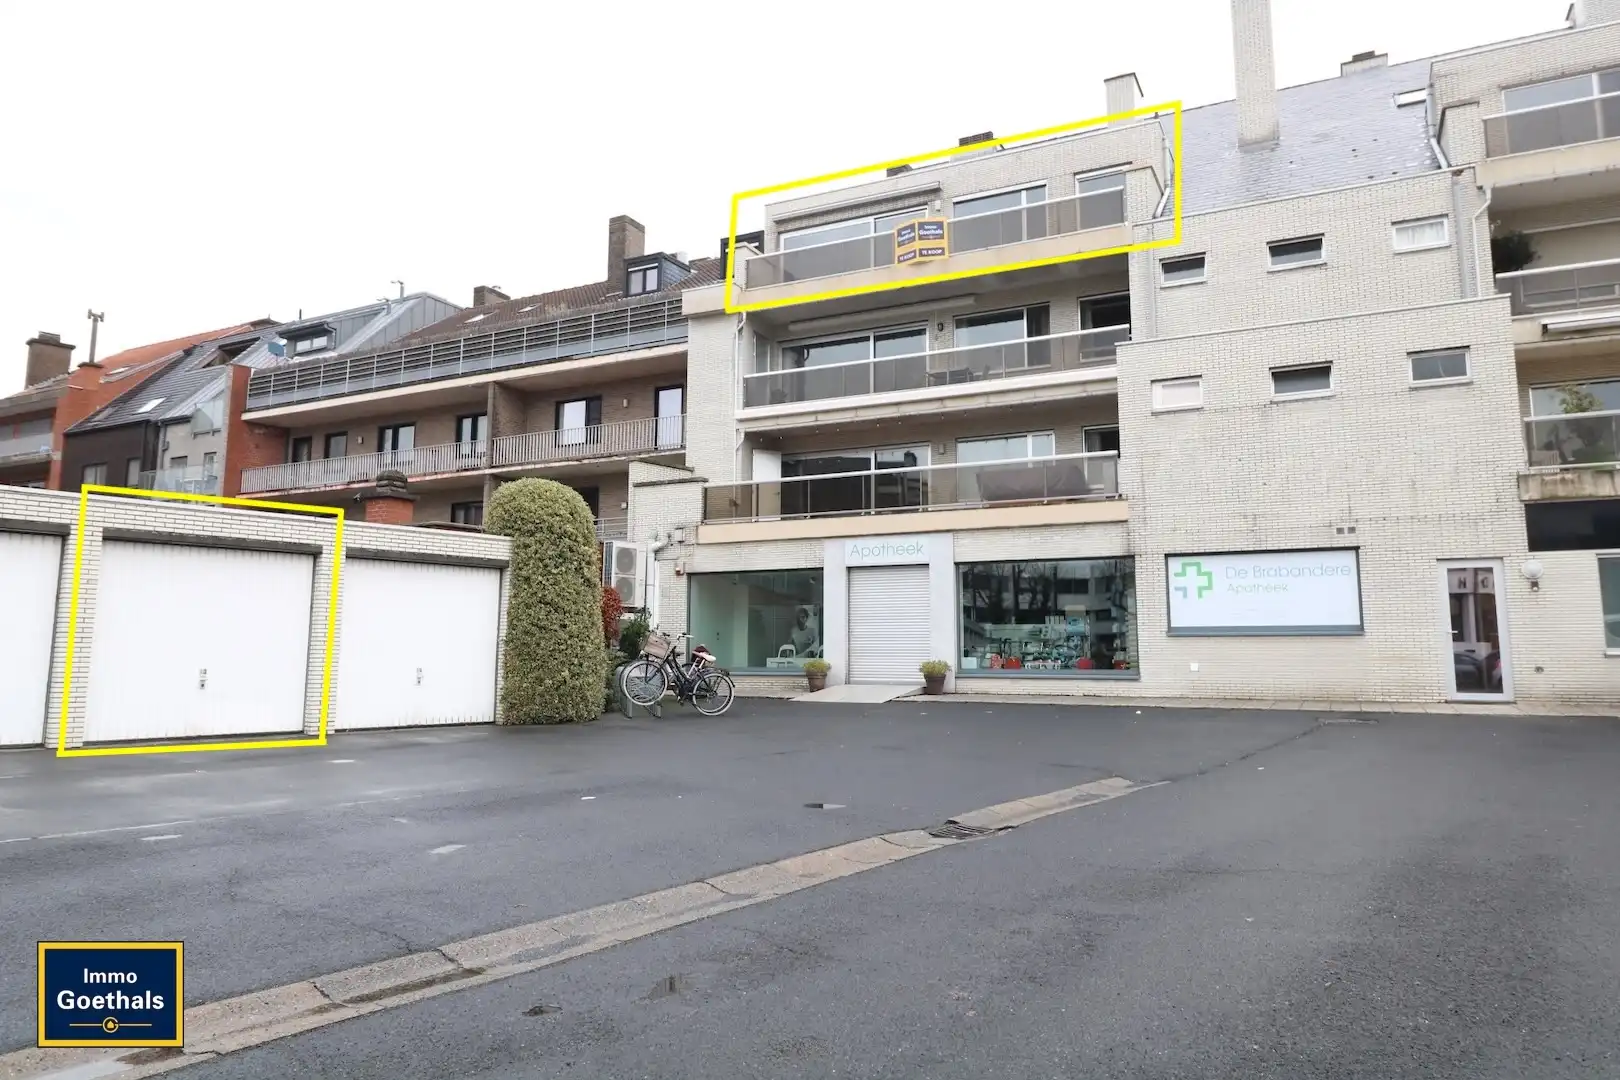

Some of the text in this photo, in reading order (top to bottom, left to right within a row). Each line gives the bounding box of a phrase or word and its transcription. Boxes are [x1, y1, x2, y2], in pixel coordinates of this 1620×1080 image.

[849, 540, 924, 560] Apotheek
[1225, 563, 1352, 579] De Brabandere
[1227, 582, 1289, 595] Apotheek
